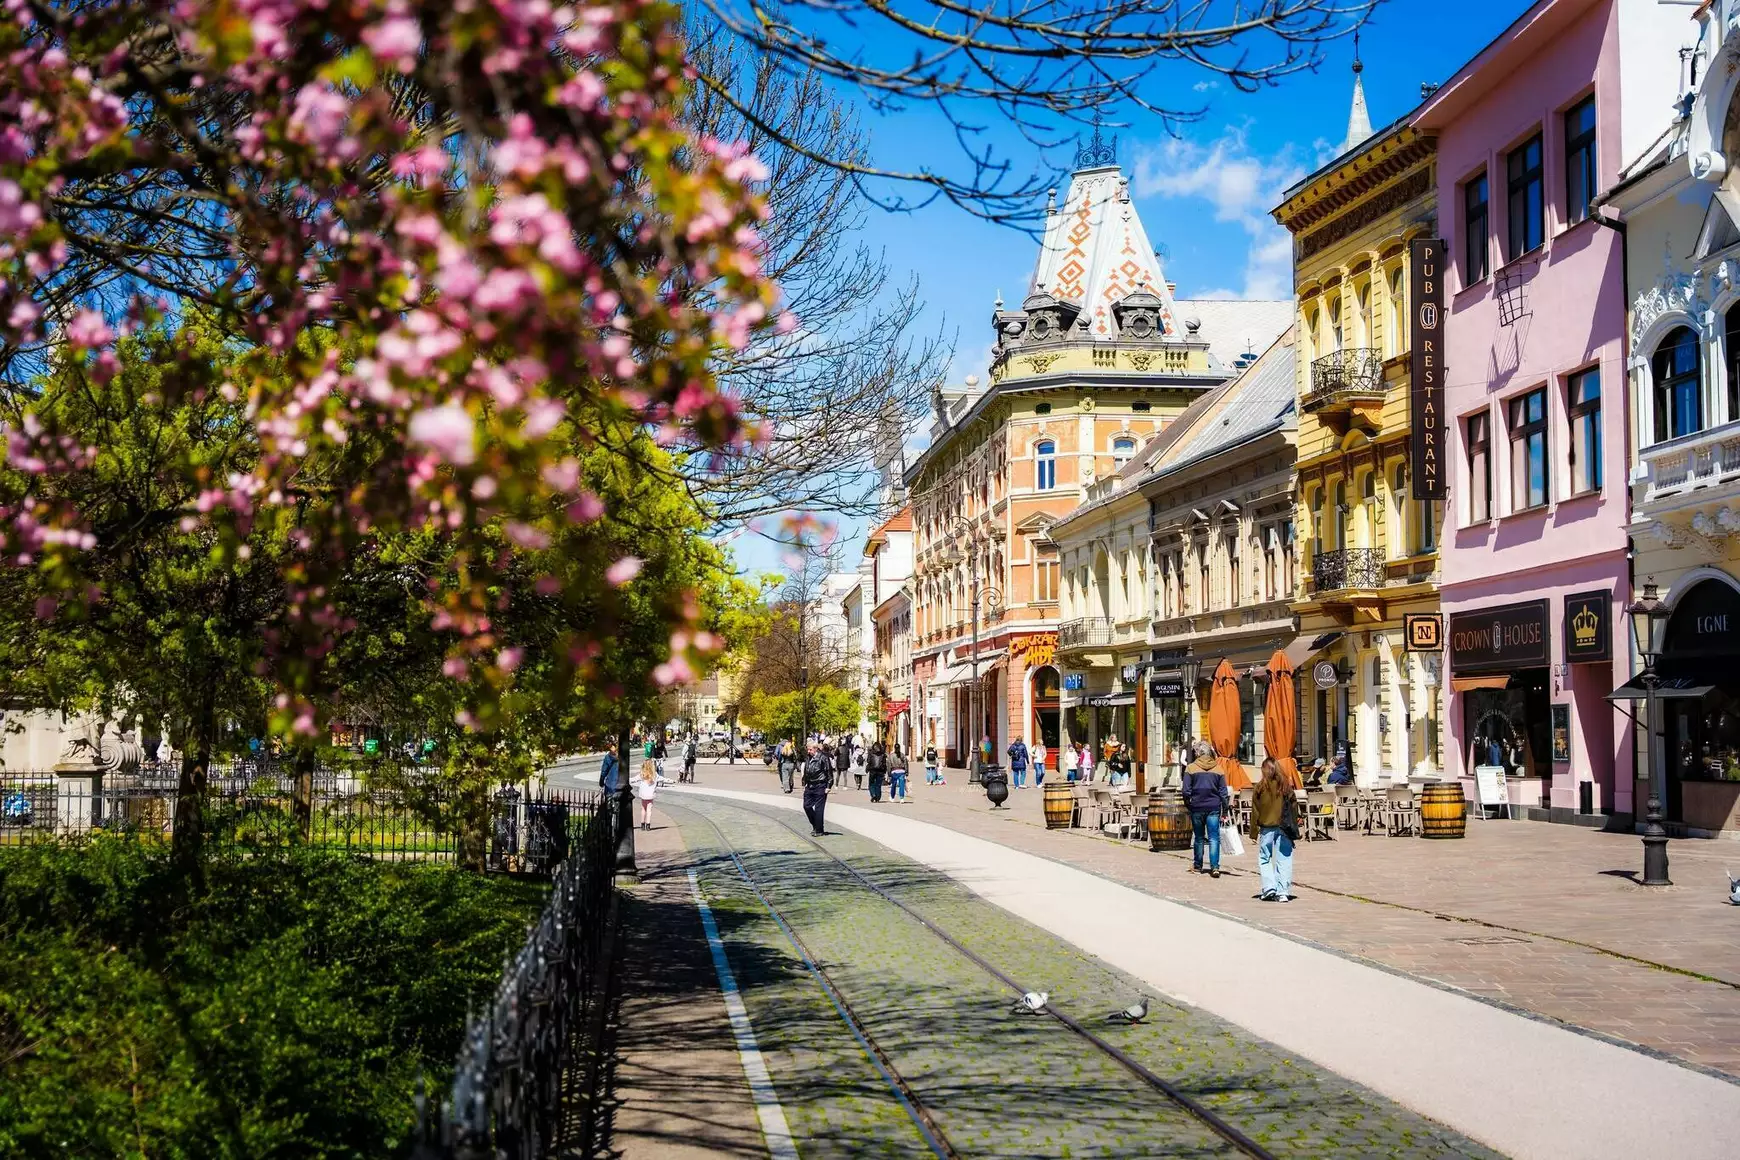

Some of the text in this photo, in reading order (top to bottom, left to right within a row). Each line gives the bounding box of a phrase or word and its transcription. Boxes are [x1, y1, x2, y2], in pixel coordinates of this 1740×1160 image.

[1424, 247, 1434, 294] PUB
[1424, 340, 1436, 491] RESTAURANT
[1454, 628, 1490, 652] CROWN
[1504, 622, 1541, 646] HOUSE
